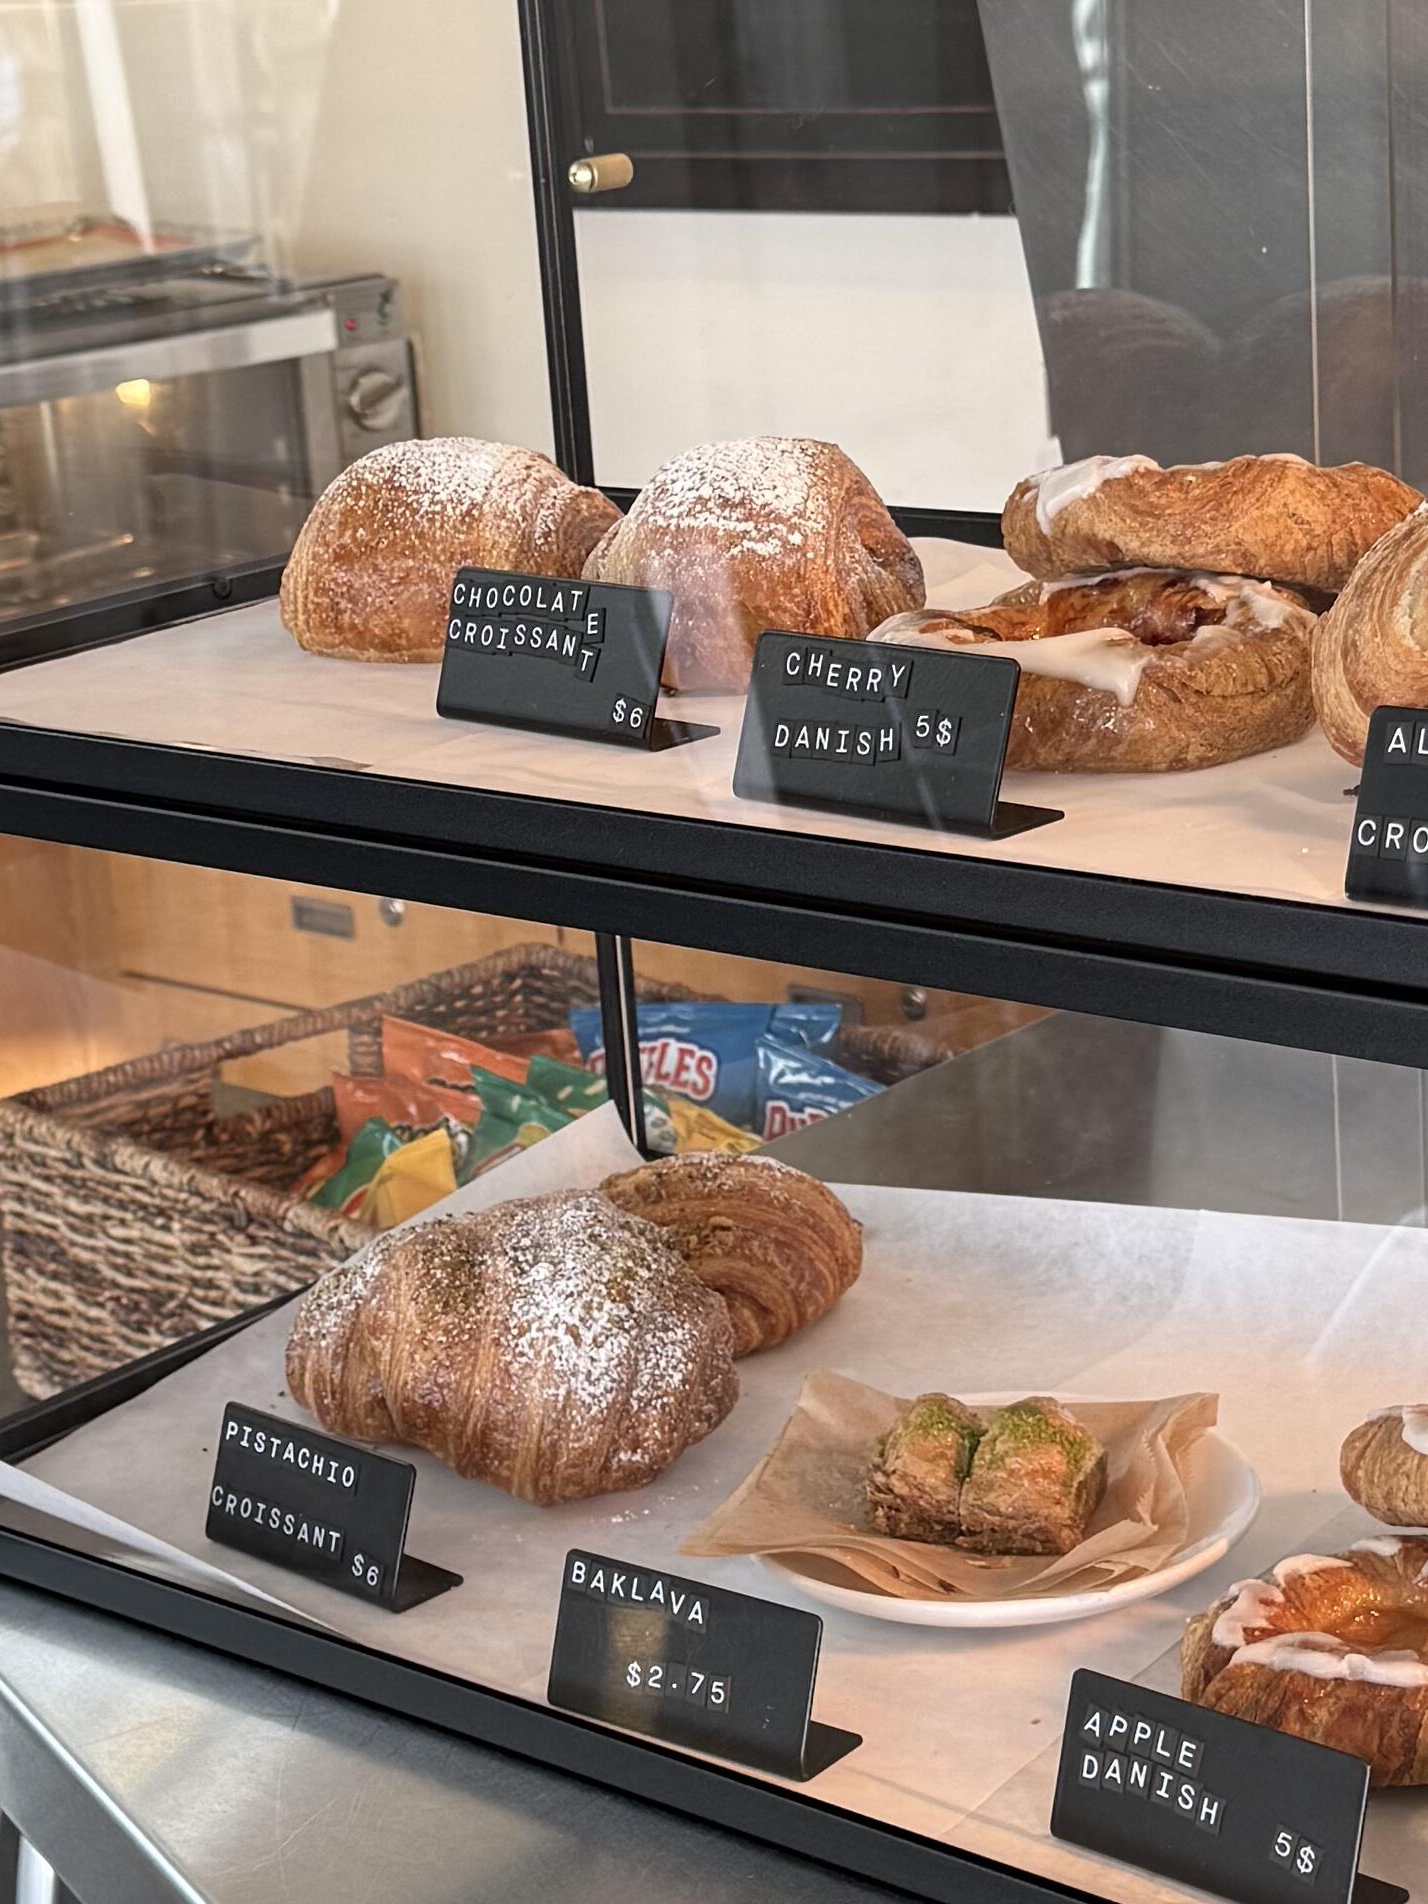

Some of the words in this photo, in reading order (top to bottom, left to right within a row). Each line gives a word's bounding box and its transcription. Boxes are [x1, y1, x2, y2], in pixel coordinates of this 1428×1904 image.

[448, 618, 593, 674] CROISSANT
[786, 652, 906, 692] CHERRY
[612, 697, 643, 729] $6
[775, 722, 894, 756] DANISH
[915, 714, 952, 747] 5$
[225, 1422, 355, 1489] PISTACHIO
[212, 1486, 340, 1553] CROISSANT
[352, 1554, 379, 1587] $6
[572, 1561, 704, 1624] BAKLAVA
[627, 1662, 725, 1704] $2.75
[1082, 1712, 1198, 1768] APPLE
[1081, 1754, 1220, 1826] DANISH
[1275, 1831, 1315, 1874] 5$
